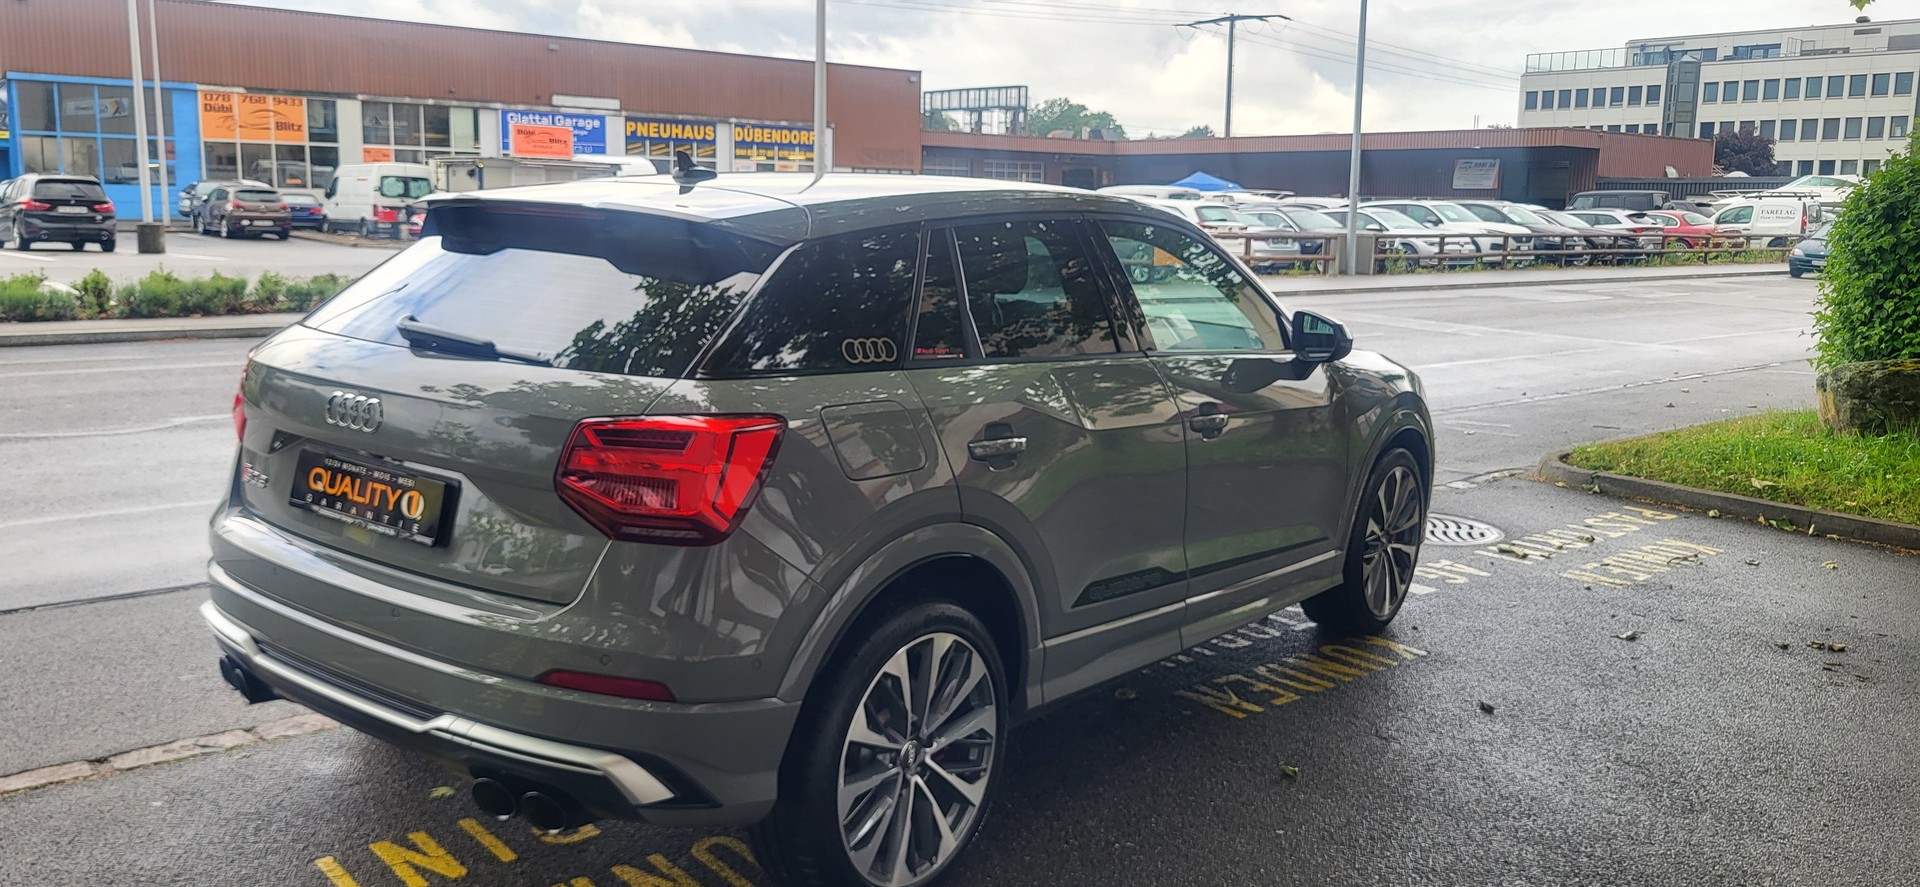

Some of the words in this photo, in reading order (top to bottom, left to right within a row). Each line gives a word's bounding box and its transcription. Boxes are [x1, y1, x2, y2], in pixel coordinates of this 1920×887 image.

[204, 93, 231, 102] 078
[241, 95, 267, 104] 768
[272, 97, 304, 107] 9433
[204, 103, 233, 113] Dübi
[275, 121, 304, 132] Blitz
[506, 112, 552, 125] Glattal
[554, 115, 601, 130] Garage
[626, 121, 715, 141] PNEUHAUS
[735, 124, 815, 144] DÜBENDORF
[341, 462, 367, 475] MONATE
[308, 467, 403, 512] QUALITY
[304, 493, 421, 534] GARANTIE
[1173, 634, 1429, 719] KUNDEN
